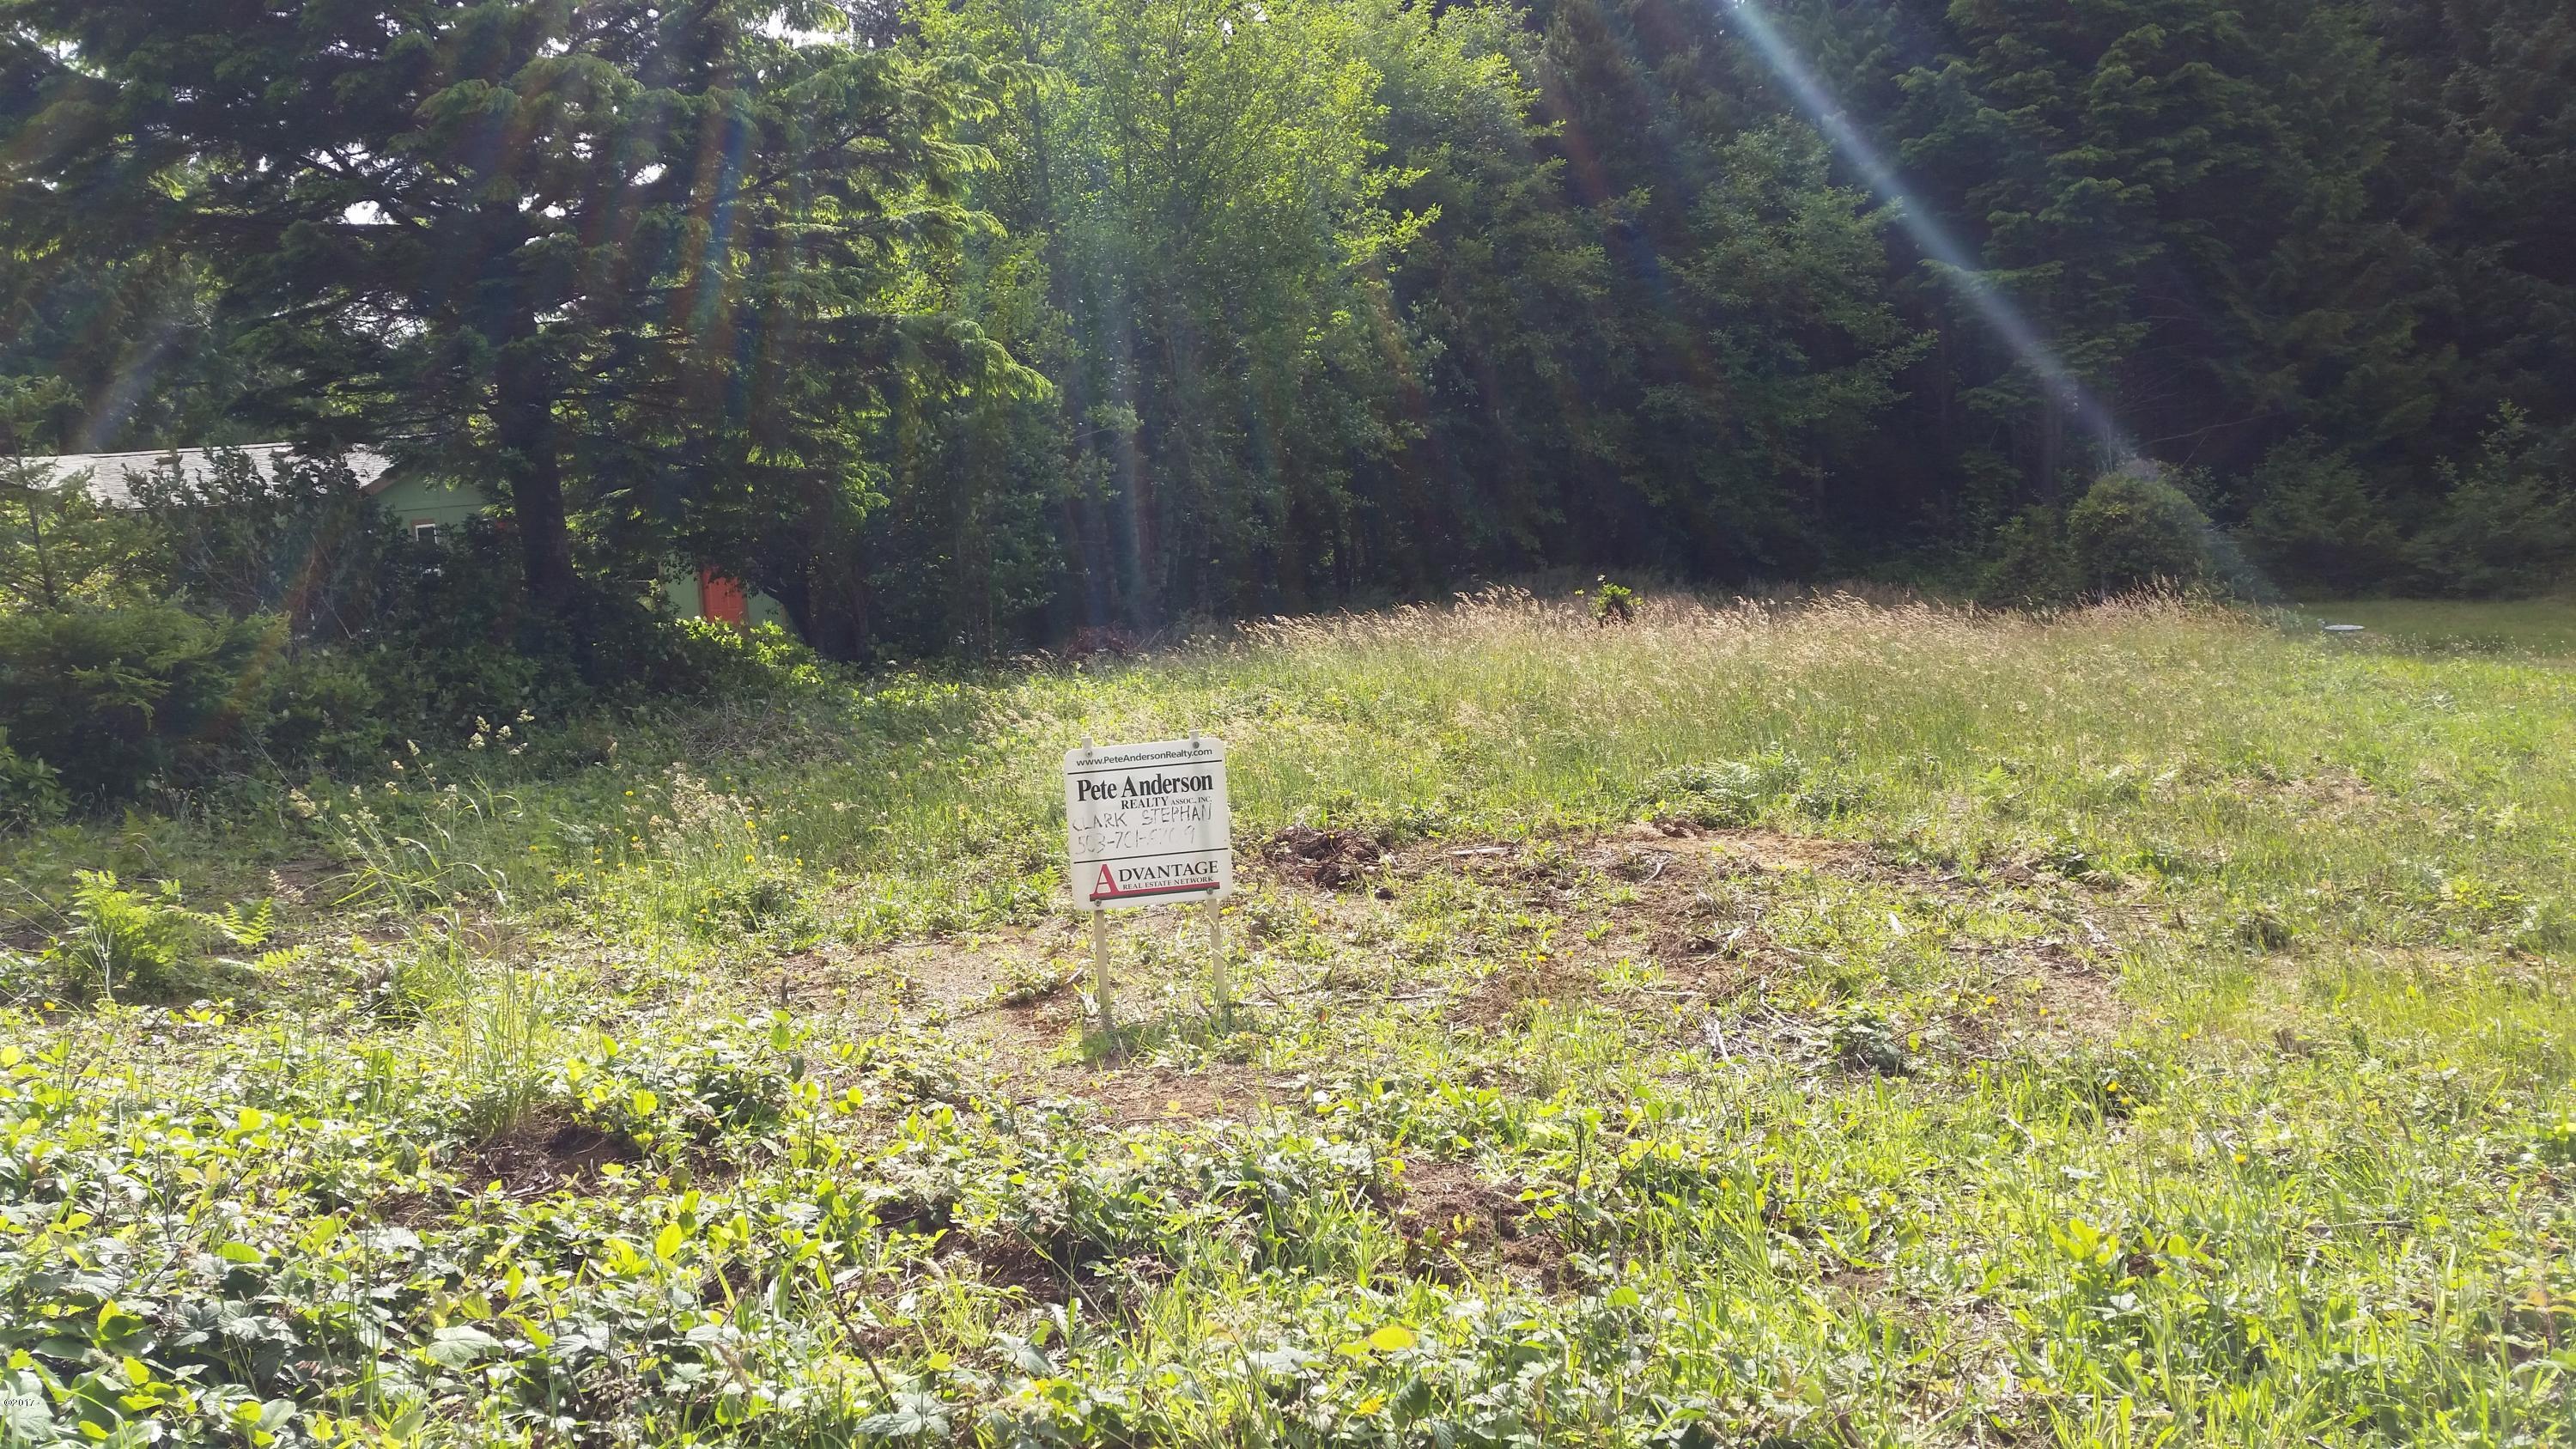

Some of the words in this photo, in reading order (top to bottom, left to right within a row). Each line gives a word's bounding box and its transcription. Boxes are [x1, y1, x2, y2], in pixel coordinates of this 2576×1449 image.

[1076, 748, 1212, 766] www.PeteAndersonRealty.com
[1076, 778, 1117, 802] Pete
[1121, 773, 1214, 798] Anderson
[1121, 795, 1169, 810] REALTY
[1090, 861, 1219, 900] ADVANTAGE
[1122, 882, 1142, 891] REAL
[1145, 880, 1173, 889] ESTATE
[1174, 875, 1214, 886] NETWORK
